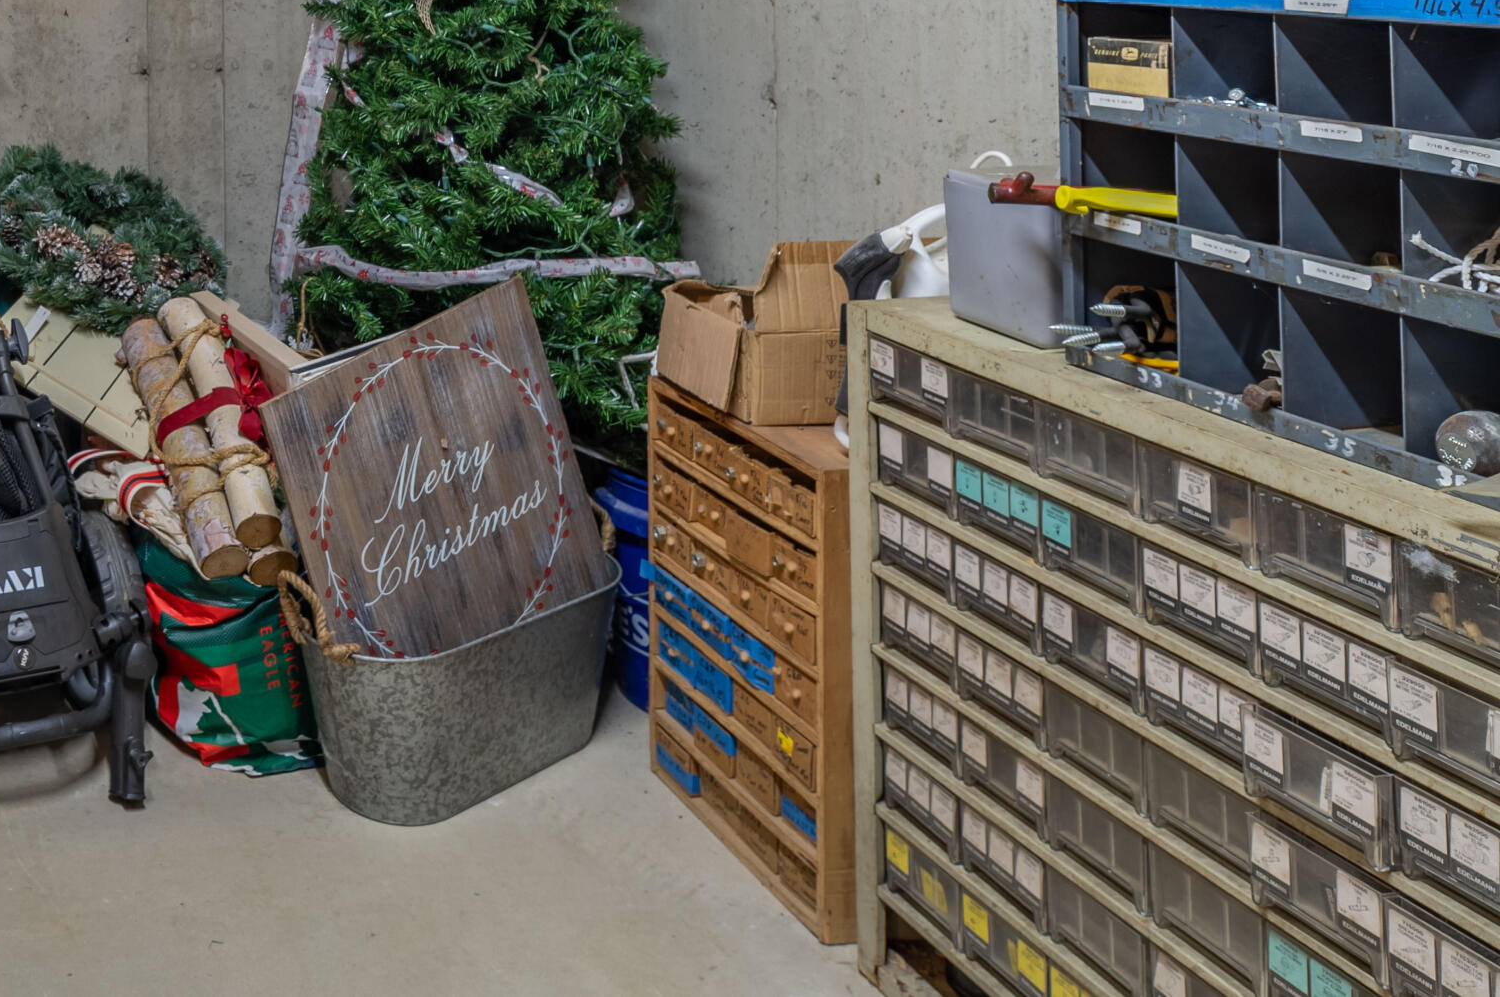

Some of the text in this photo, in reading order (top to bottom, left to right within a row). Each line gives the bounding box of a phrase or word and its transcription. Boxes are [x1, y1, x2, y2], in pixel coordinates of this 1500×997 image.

[1137, 367, 1163, 388] 33
[1323, 433, 1356, 456] 35
[374, 436, 495, 524] Merry
[361, 479, 548, 608] Christmas
[1350, 574, 1386, 594] EDELMANN
[260, 626, 281, 690] EAGLE
[278, 613, 304, 708] MERICAN
[1395, 718, 1433, 743] EDELMANN
[1335, 810, 1372, 837] EDELMANN
[1406, 838, 1444, 865] EDELMANN
[1456, 867, 1497, 894] EDELMANN
[1395, 962, 1433, 991] EDELMANN
